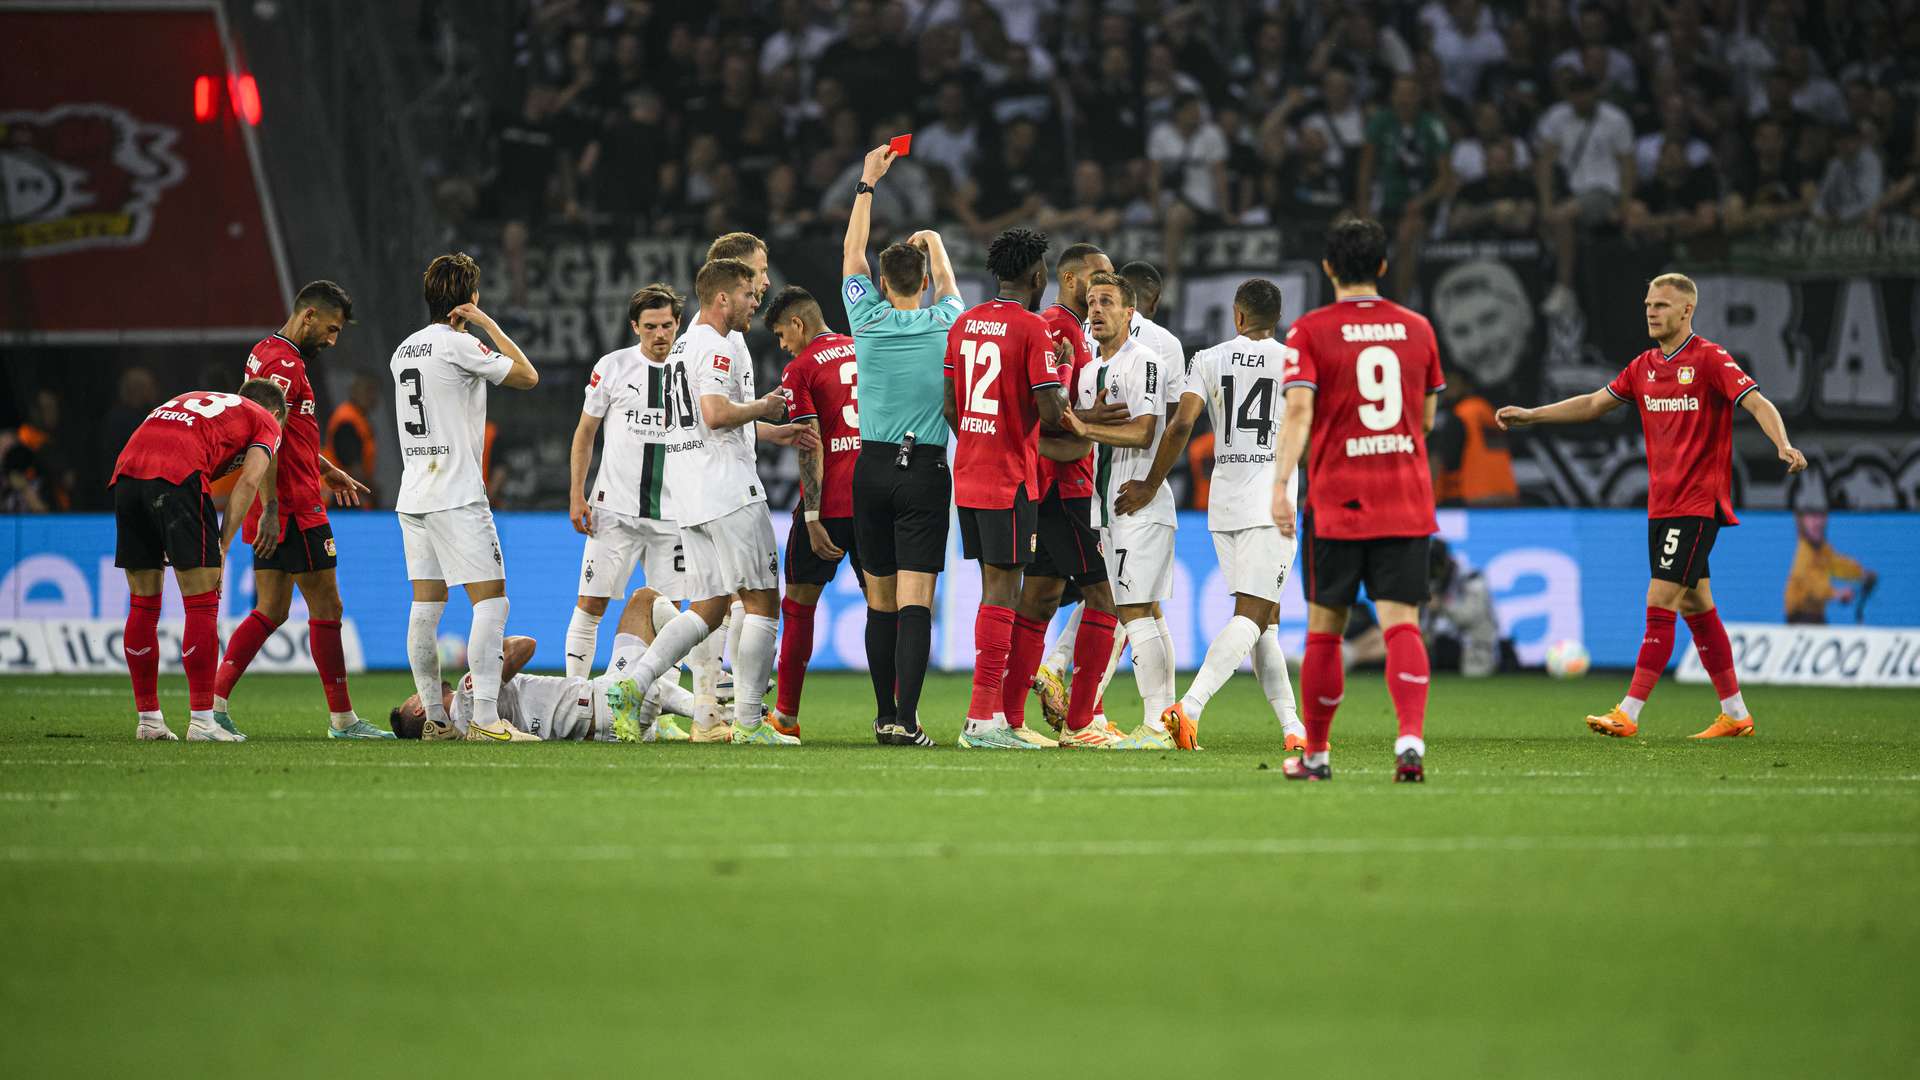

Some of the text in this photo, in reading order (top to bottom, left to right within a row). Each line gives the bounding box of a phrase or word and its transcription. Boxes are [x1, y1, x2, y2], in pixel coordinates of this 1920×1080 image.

[964, 319, 1008, 337] TAPSOBA
[1341, 322, 1408, 342] SARDAR
[1231, 352, 1265, 368] PLEA
[959, 339, 1002, 416] 12
[1356, 345, 1403, 431] 9
[400, 367, 430, 438] 3
[1221, 374, 1278, 449] 14
[1643, 394, 1699, 412] Barmenia
[960, 416, 997, 436] AYER04
[831, 436, 861, 452] BAYE
[1345, 434, 1415, 457] BAYER04
[1664, 528, 1681, 555] 5
[1115, 549, 1128, 577] 7
